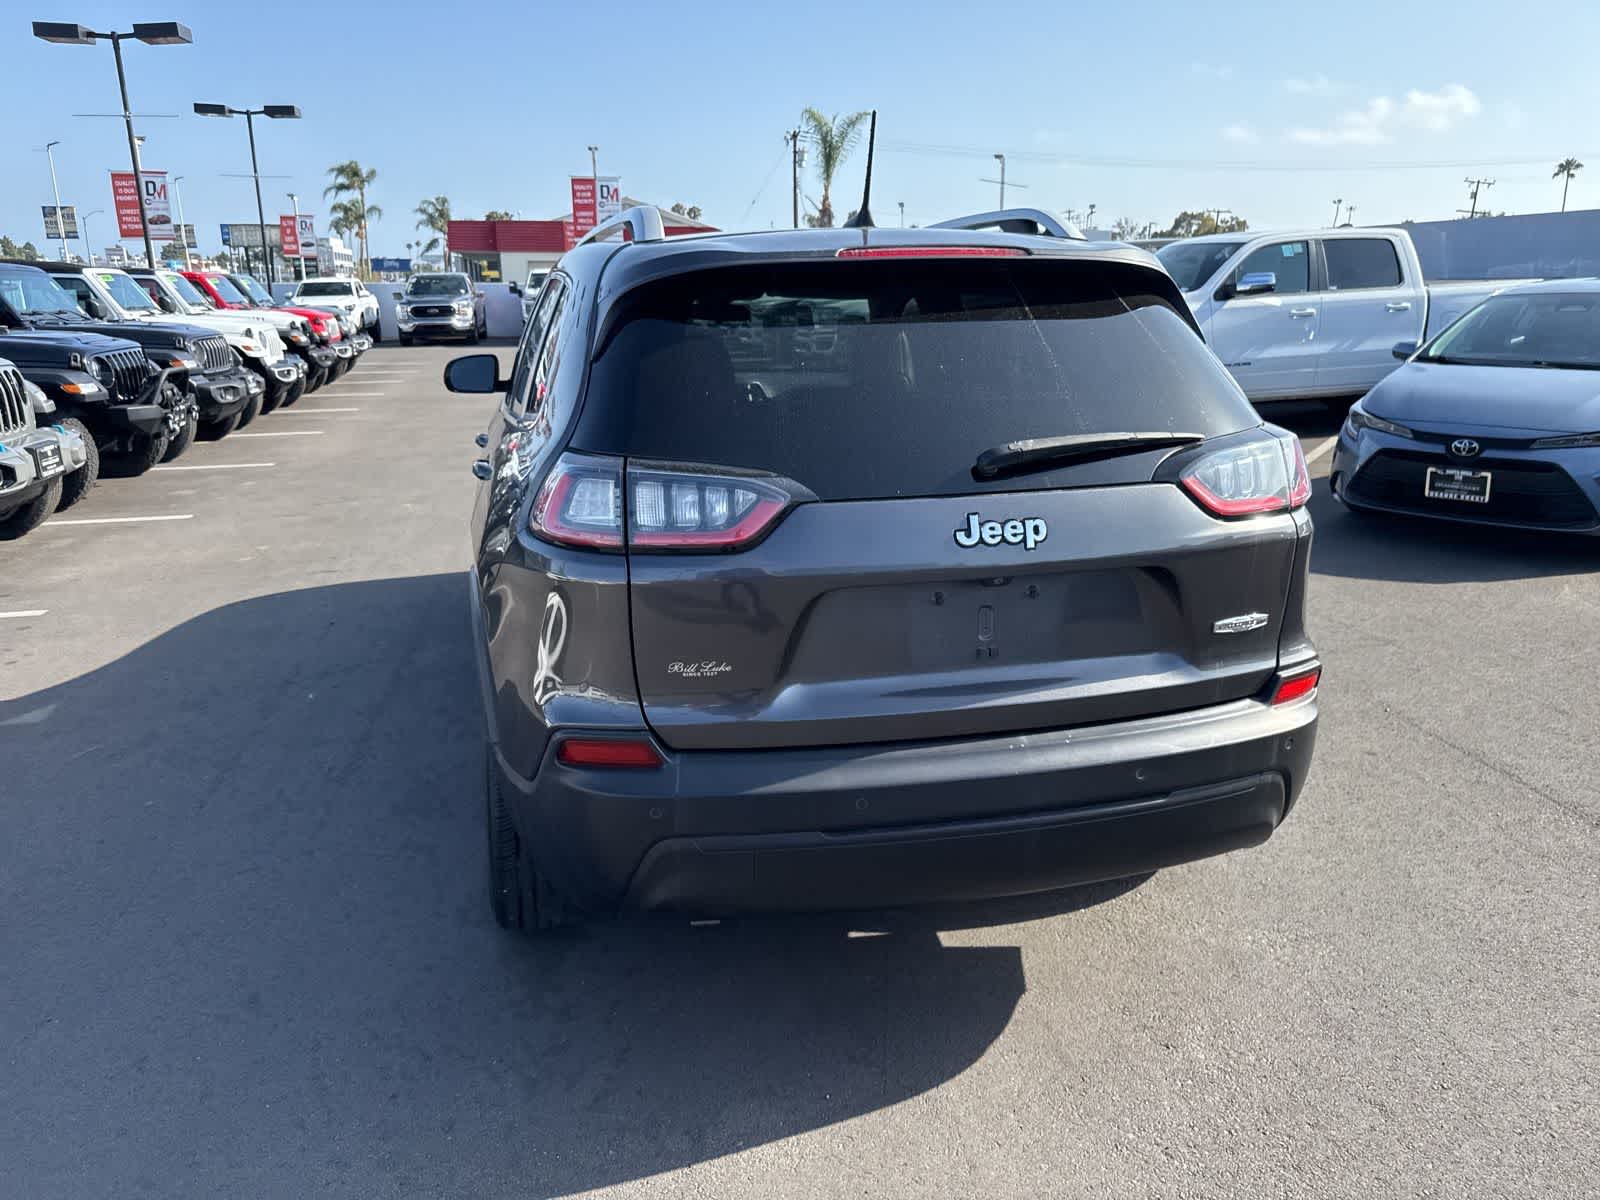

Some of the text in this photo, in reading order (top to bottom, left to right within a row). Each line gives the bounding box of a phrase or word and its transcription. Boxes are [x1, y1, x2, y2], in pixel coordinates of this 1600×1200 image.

[953, 512, 1047, 550] Jeep
[668, 661, 732, 672] Bill Luke
